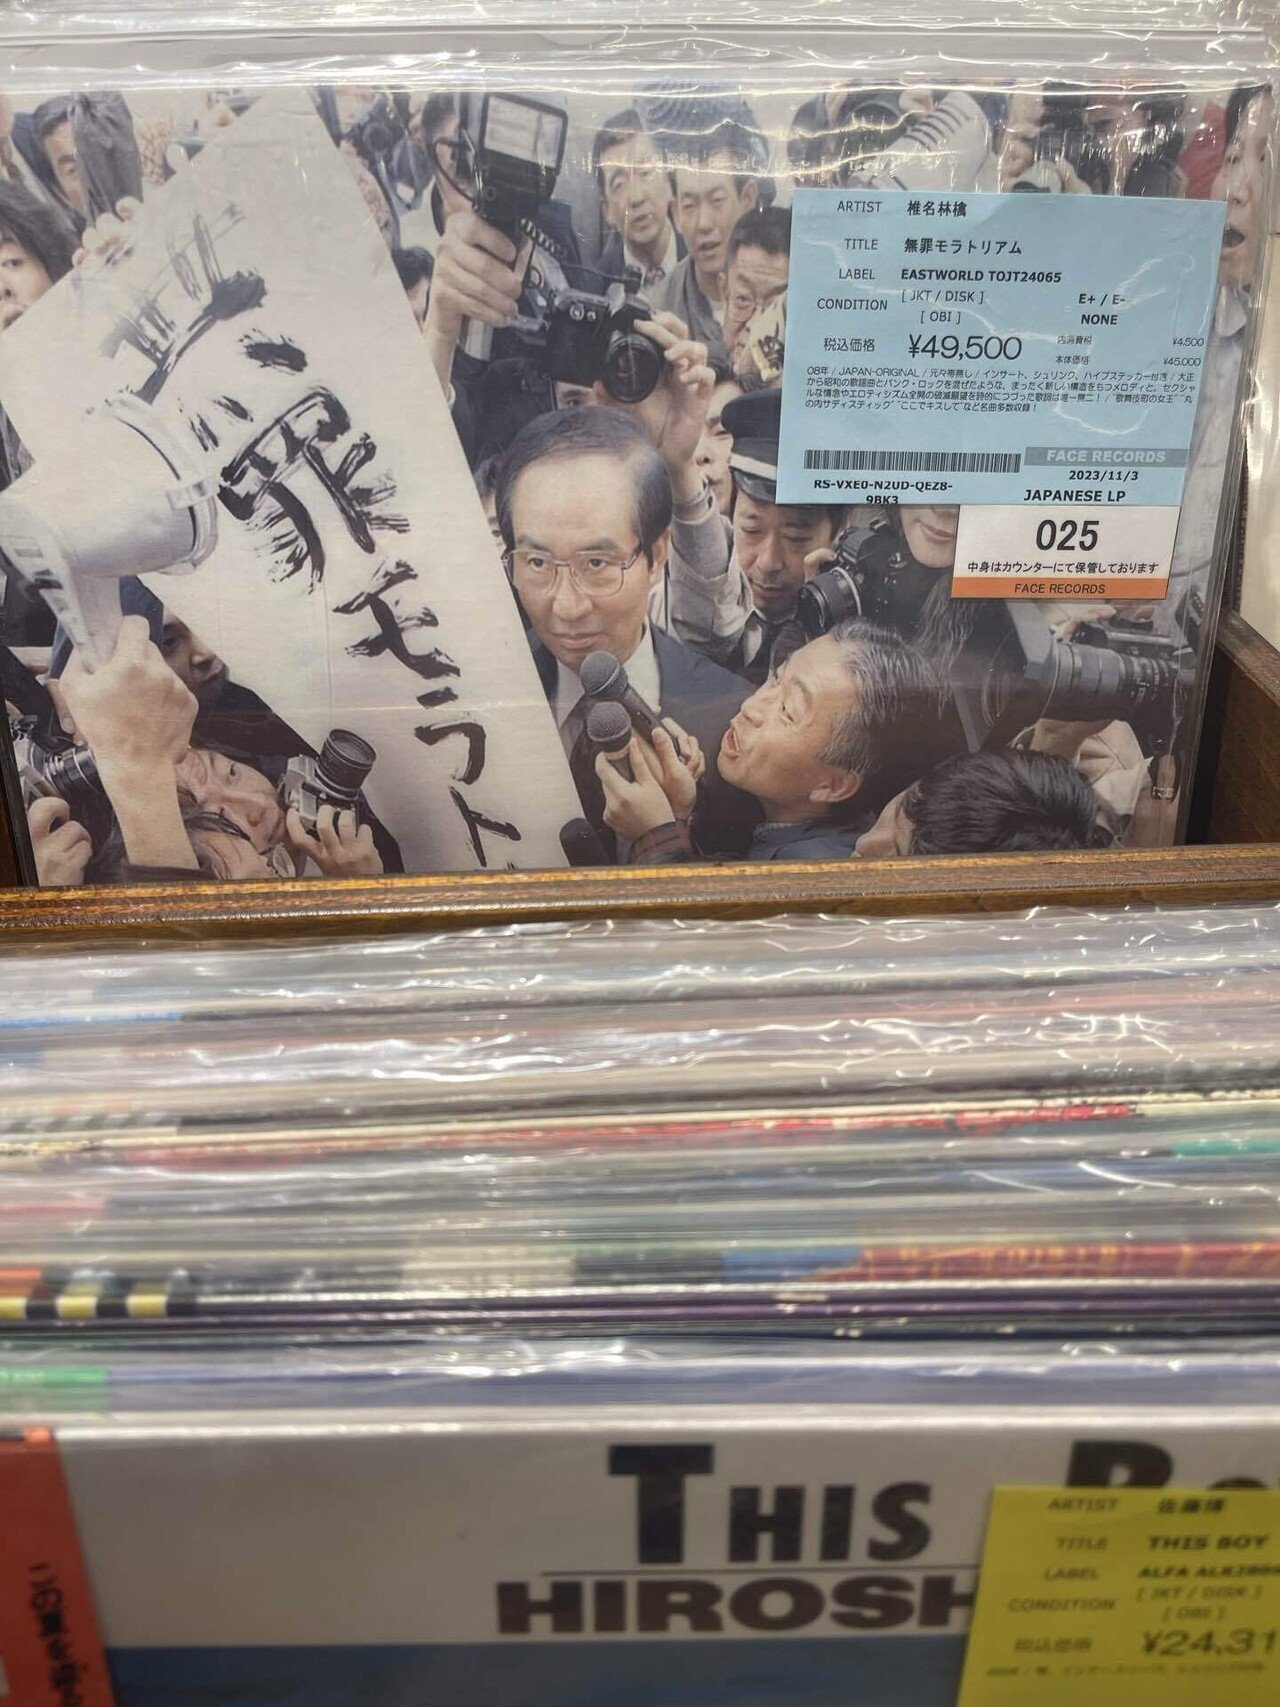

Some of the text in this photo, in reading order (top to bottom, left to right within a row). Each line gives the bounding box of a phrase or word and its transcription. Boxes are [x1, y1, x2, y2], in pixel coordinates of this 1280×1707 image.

[837, 201, 882, 213] ARTIST
[906, 200, 968, 217] 椎名林檎
[844, 238, 878, 250] TITLE
[904, 237, 1022, 255] 無罪モラトリアム
[838, 269, 875, 280] LABEL
[901, 269, 1061, 283] EASTWORLD TOJT24065
[911, 290, 932, 302] JKT
[945, 291, 975, 302] DISK
[1079, 293, 1095, 304] E+
[817, 298, 888, 310] CONDITION
[930, 311, 952, 322] OBI
[1081, 314, 1118, 325] NONE
[823, 337, 876, 352] 税込価格
[908, 334, 1022, 360] ¥49,500
[1055, 356, 1089, 365] 本体価格
[807, 366, 829, 376] 08年
[839, 366, 920, 378] JAPAN-ORIGINAL
[1178, 372, 1195, 382] 大正
[1047, 450, 1165, 463] FACE RECORDS
[1069, 470, 1139, 482] 2023/11/3
[1024, 489, 1126, 502] JAPANESE LP
[1036, 519, 1099, 551] 025
[967, 561, 1159, 574] 中身はカウンターにて保管しております
[1014, 583, 1106, 594] FACE RECORDS
[1048, 1497, 1119, 1512] ARTIST
[1055, 1536, 1109, 1551] TITLE
[1149, 1534, 1270, 1551] THIS BOY
[1045, 1566, 1100, 1582] LABEL
[1008, 1597, 1116, 1613] CONDITION
